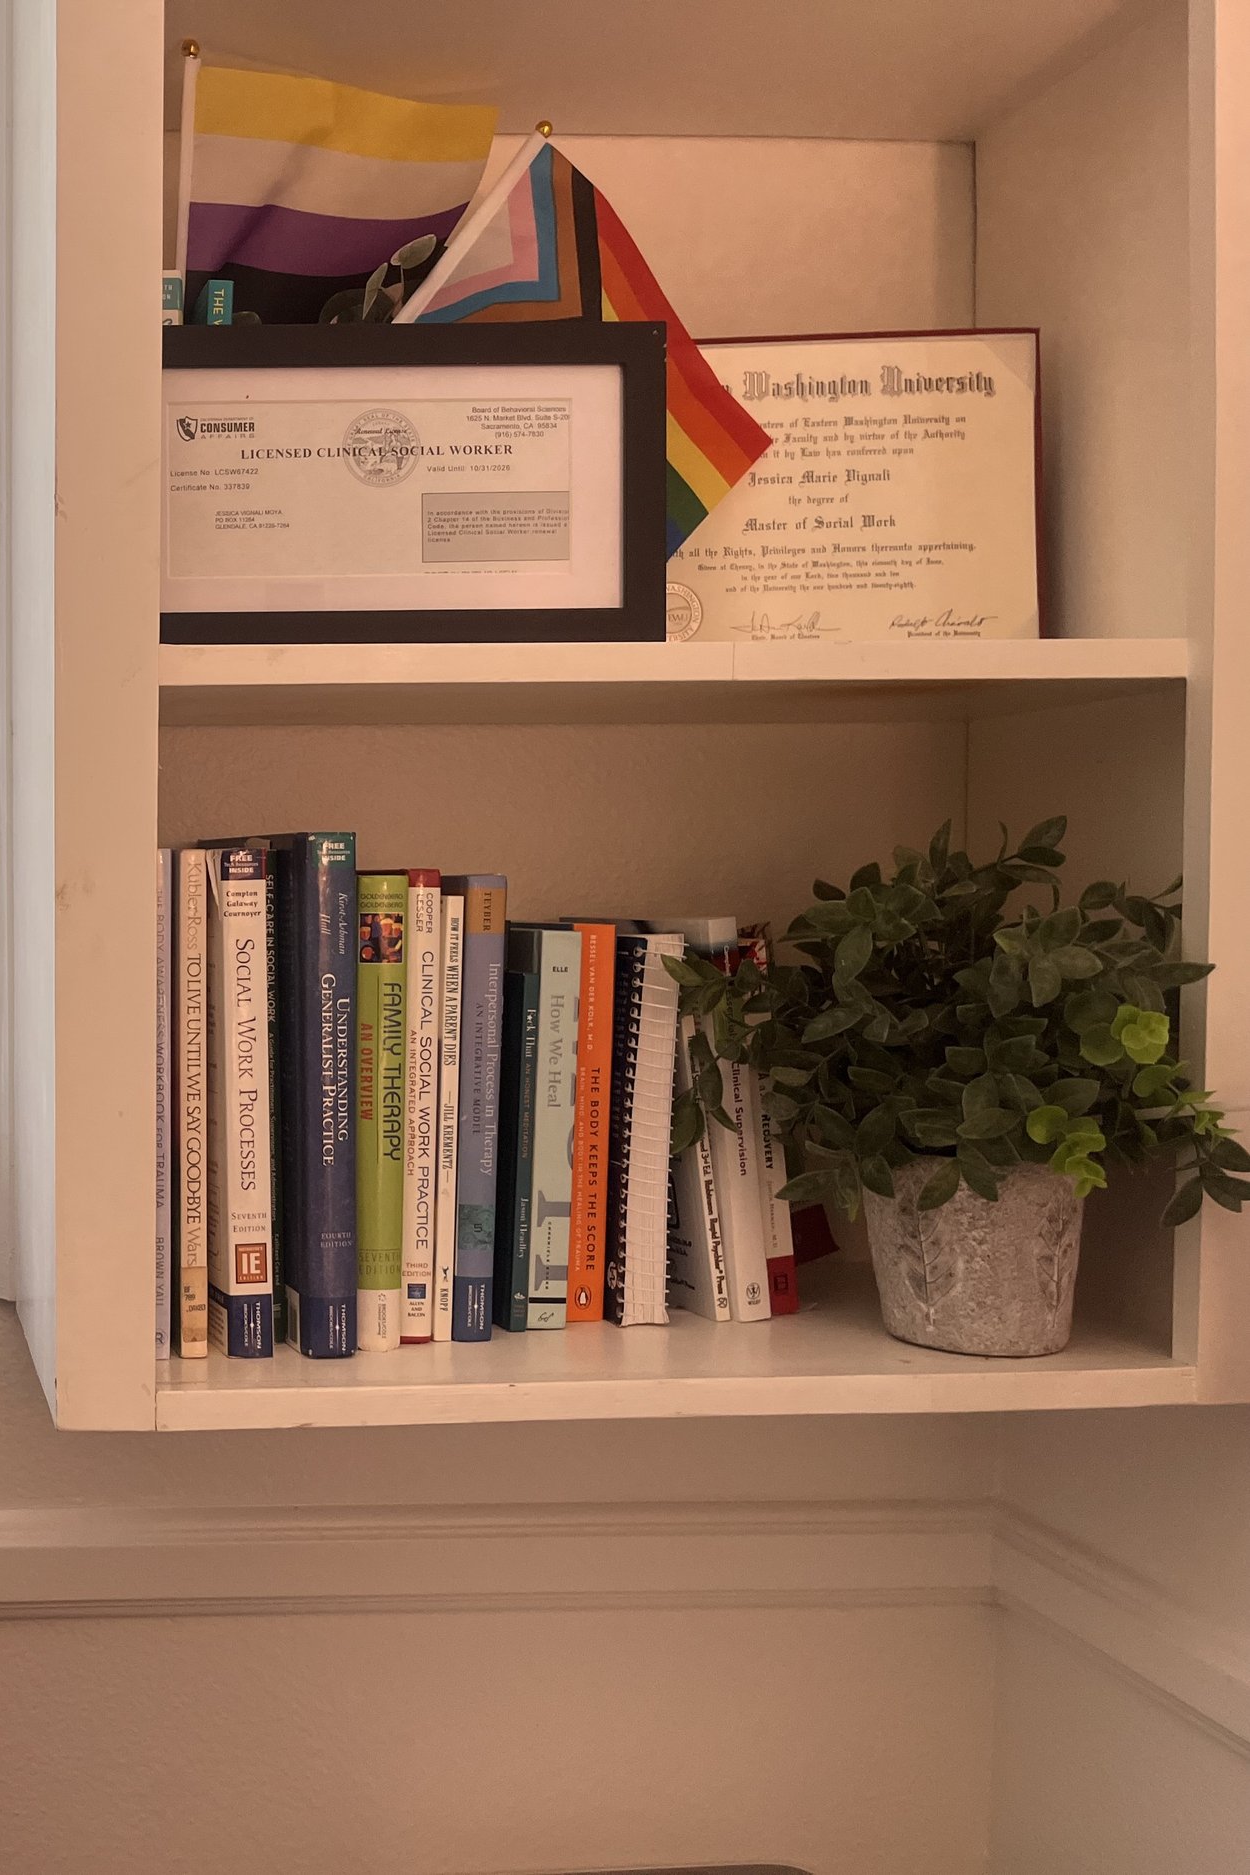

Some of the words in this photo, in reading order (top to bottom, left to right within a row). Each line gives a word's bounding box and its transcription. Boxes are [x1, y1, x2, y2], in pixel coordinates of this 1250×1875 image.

[213, 288, 225, 315] THE
[742, 370, 871, 403] Washington
[880, 364, 996, 398] University
[200, 422, 255, 433] CONSUMER
[789, 418, 799, 429] of
[843, 416, 898, 428] Washington
[902, 414, 951, 427] University
[241, 448, 312, 460] LICENSED
[316, 446, 386, 459] CLINICAL
[390, 445, 445, 457] SOCIAL
[450, 444, 513, 455] WORKER
[170, 469, 198, 478] License
[170, 483, 208, 492] Certificate
[747, 472, 793, 488] Jessica
[798, 469, 838, 489] Marie
[844, 468, 891, 487] Vignali
[788, 495, 801, 505] the
[806, 495, 835, 507] degree
[839, 493, 850, 504] of
[741, 518, 788, 535] Master
[795, 516, 808, 530] of
[811, 515, 854, 533] Social
[860, 514, 897, 532] Work
[688, 548, 700, 558] all
[705, 547, 718, 559] the
[811, 544, 827, 555] and
[230, 854, 253, 862] FREE
[226, 890, 258, 898] Compton
[226, 900, 258, 908] Galaway
[265, 874, 275, 936] SELF-CARE
[360, 901, 404, 909] GOLDENBERG
[223, 910, 262, 918] Cournoyer
[415, 893, 424, 933] LESSER
[425, 892, 434, 934] COOPER
[450, 917, 460, 932] HOW
[482, 892, 492, 932] TEYBER
[449, 941, 459, 963] FEELS
[589, 934, 597, 963] BESSEL
[187, 953, 202, 978] TO
[235, 938, 255, 1008] SOCIAL
[267, 950, 276, 988] SOCIAL
[445, 964, 459, 994] WHEN
[588, 966, 596, 985] VAN
[187, 979, 202, 1015] LIVE
[267, 990, 277, 1023] WORK
[420, 951, 434, 1031] CLINICAL
[484, 963, 501, 1048] Interpersonal
[383, 982, 402, 1057] FAMILY
[444, 1004, 458, 1042] PARENT
[475, 1002, 484, 1018] AN
[550, 994, 565, 1034] How
[321, 973, 336, 1079] GENERALIST
[360, 1023, 373, 1042] AN
[410, 1029, 417, 1044] AN
[187, 1018, 202, 1072] UNTIL
[237, 1015, 257, 1079] WORK
[443, 1043, 457, 1067] DIES
[473, 1022, 483, 1095] INTEGRATIVE
[525, 1036, 536, 1058] That
[548, 1037, 563, 1066] We
[337, 997, 350, 1142] UNDERSTANDING
[360, 1047, 373, 1121] OVERVIEW
[408, 1049, 417, 1114] INTEGRATED
[418, 1036, 432, 1101] SOCIAL
[485, 1053, 499, 1101] Process
[590, 1067, 600, 1094] THE
[731, 1062, 744, 1103] Clinical
[187, 1072, 202, 1102] WE
[547, 1071, 561, 1108] Heal
[187, 1105, 202, 1135] SAY
[322, 1084, 337, 1167] PRACTICE
[382, 1062, 402, 1161] THERAPY
[472, 1099, 481, 1134] MODEL
[485, 1105, 494, 1117] in
[589, 1100, 600, 1137] BODY
[238, 1088, 258, 1191] PROCESSES
[407, 1118, 416, 1177] APPROACH
[417, 1106, 431, 1159] WORK
[521, 1111, 530, 1159] MEDITATION
[735, 1106, 748, 1177] Supervision
[480, 1123, 497, 1176] Therapy
[588, 1144, 598, 1186] KEEPS
[186, 1136, 202, 1225] GOOD-BYE
[231, 1211, 267, 1220] SEVENTH
[415, 1165, 430, 1250] PRACTICE
[519, 1197, 530, 1223] Jason
[586, 1194, 597, 1219] THE
[232, 1225, 267, 1233] EDITION
[320, 1240, 352, 1248] EDITION
[321, 1231, 352, 1240] FOURTH
[241, 1252, 261, 1275] IE
[585, 1225, 596, 1271] SCORE
[439, 1287, 449, 1312] KNOPF
